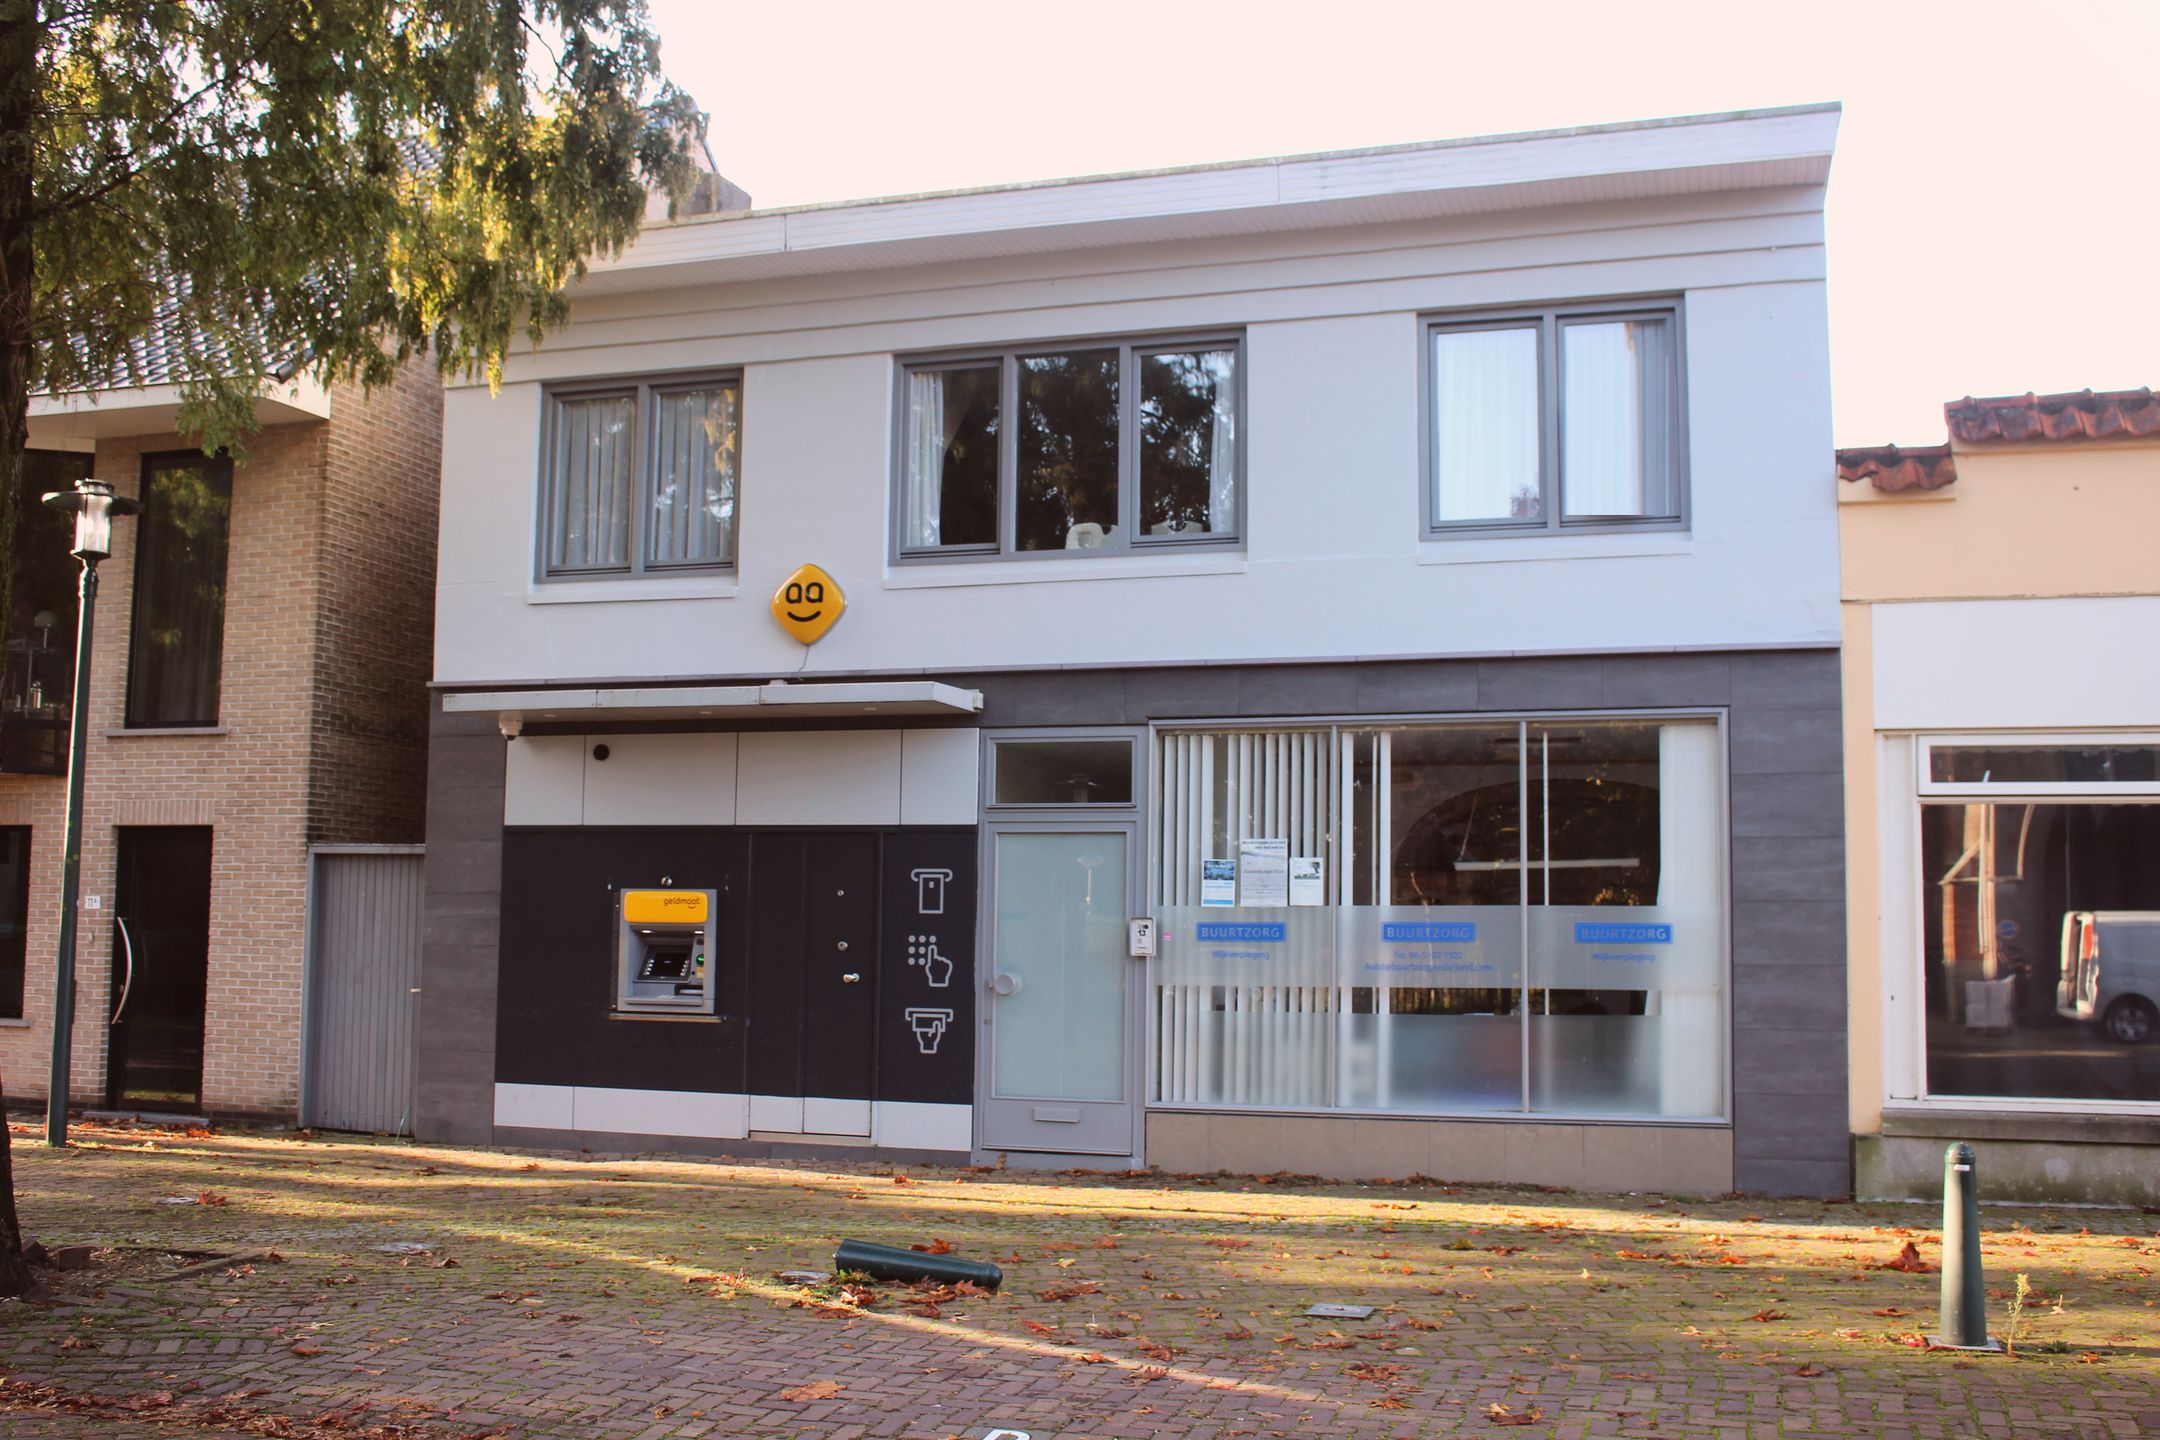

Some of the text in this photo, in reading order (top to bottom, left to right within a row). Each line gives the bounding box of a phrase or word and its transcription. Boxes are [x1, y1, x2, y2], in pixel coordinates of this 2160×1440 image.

[663, 897, 700, 907] geldmaat
[1201, 927, 1280, 938] BUURTZORG
[1387, 927, 1470, 938] BUURTZORG
[1581, 928, 1666, 939] BUURTZORG
